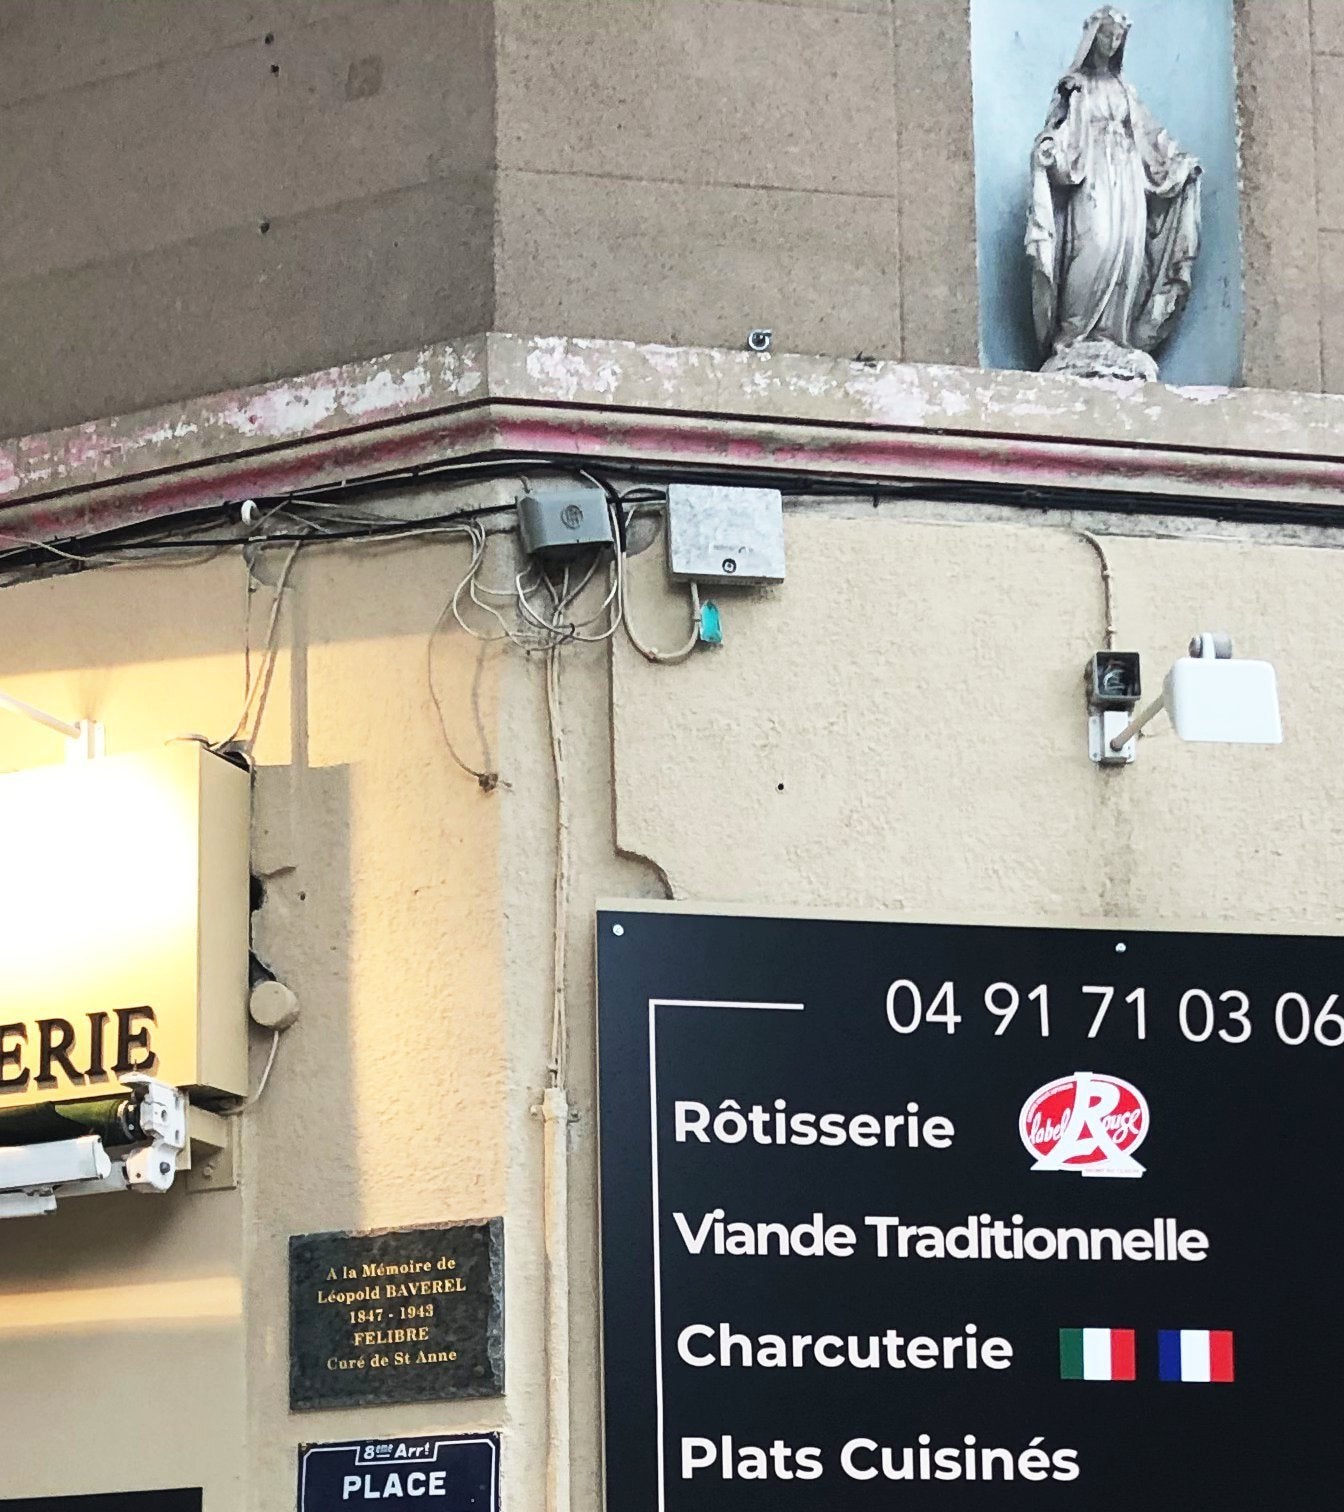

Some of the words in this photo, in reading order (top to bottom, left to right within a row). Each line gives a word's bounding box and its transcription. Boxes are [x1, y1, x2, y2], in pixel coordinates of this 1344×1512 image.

[887, 979, 961, 1034] 04
[985, 982, 1049, 1036] 91
[1082, 986, 1145, 1039] 71
[1179, 989, 1251, 1043] 03
[675, 1099, 954, 1148] Rôtisserie
[673, 1209, 856, 1256] Viande
[865, 1214, 1209, 1261] Traditionnelle
[343, 1266, 357, 1279] la
[362, 1259, 432, 1277] Mémoire
[436, 1256, 456, 1271] de
[317, 1285, 380, 1304] Léopold
[386, 1277, 466, 1298] BAVEREL
[350, 1308, 384, 1324] 1847
[400, 1303, 434, 1320] 1943
[354, 1326, 429, 1346] FELIBRE
[678, 1323, 1013, 1369] Charcuterie
[327, 1356, 365, 1371] Curé
[370, 1353, 389, 1368] de
[394, 1351, 411, 1366] St
[416, 1350, 457, 1364] Anne
[682, 1435, 823, 1479] Plats
[841, 1434, 1079, 1481] Cuisinés
[343, 1471, 446, 1499] PLACE
